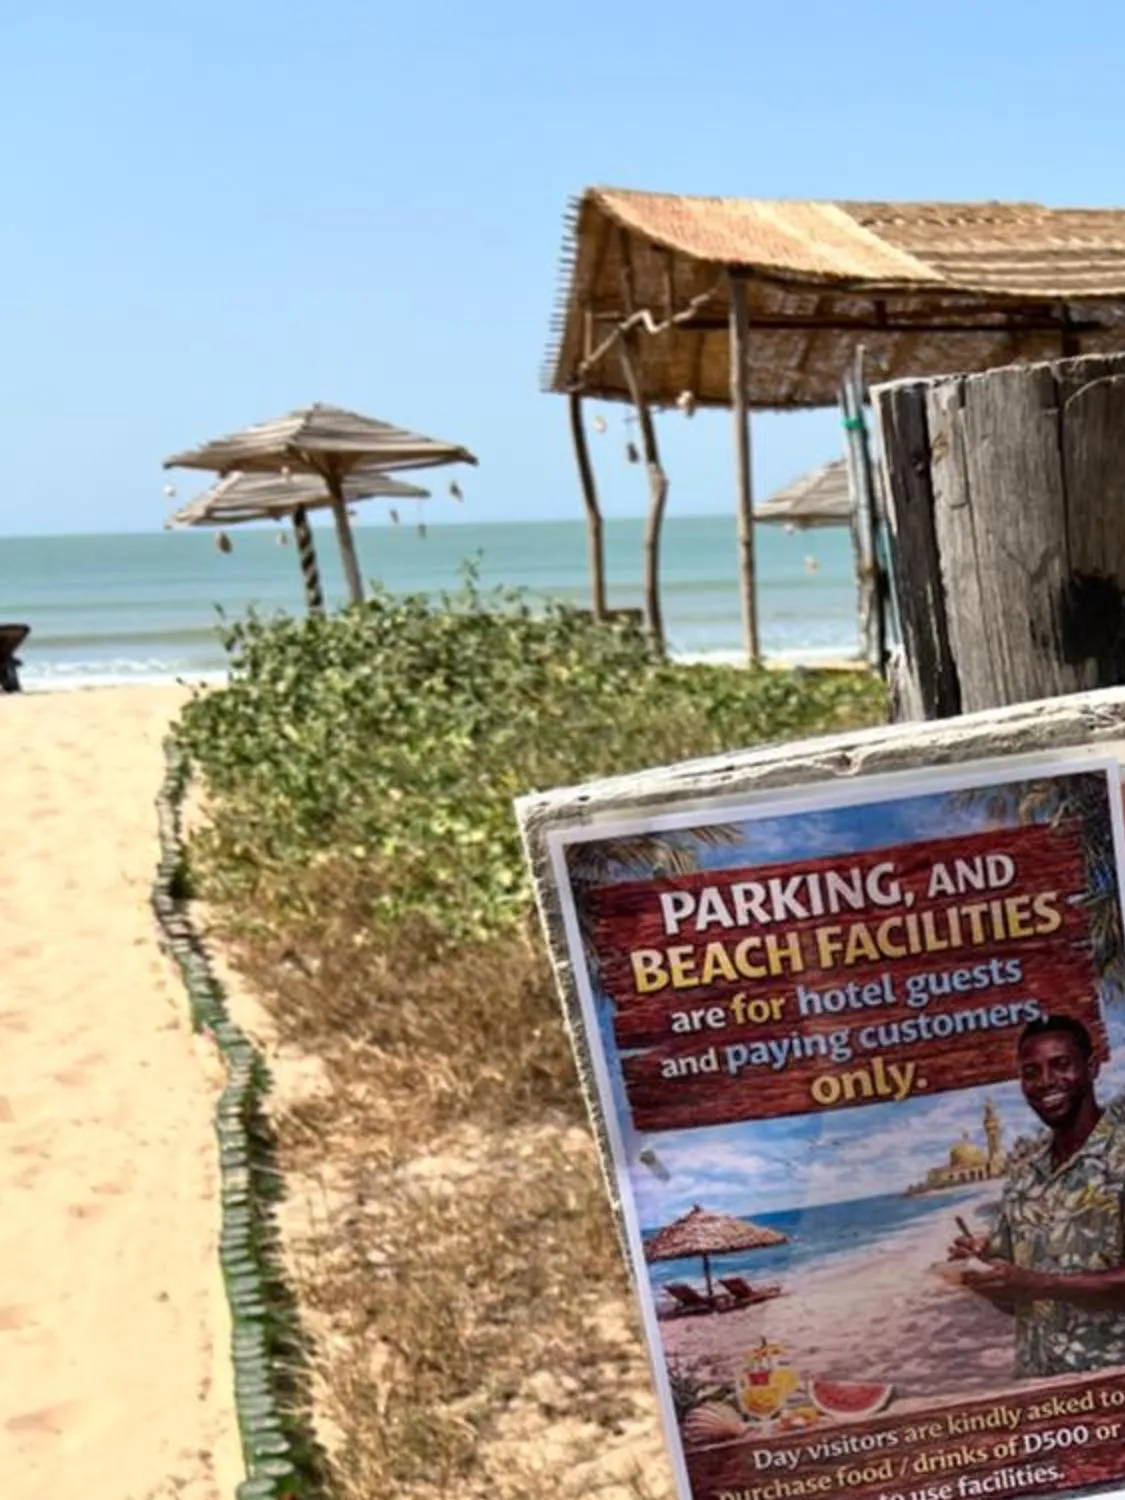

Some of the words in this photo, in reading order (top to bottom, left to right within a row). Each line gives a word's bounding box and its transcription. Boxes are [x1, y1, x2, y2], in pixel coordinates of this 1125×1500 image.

[660, 862, 916, 935] PARKING,
[928, 855, 1015, 898] AND
[631, 931, 804, 993] BEACH
[815, 892, 1062, 969] FACILITIES
[671, 1005, 726, 1033] are
[731, 992, 785, 1025] for
[797, 971, 896, 1017] hotel
[905, 958, 1022, 1007] guests
[660, 1046, 720, 1079] and
[726, 1026, 852, 1076] paying
[858, 999, 1049, 1051] customers,
[811, 1058, 927, 1107] only.
[752, 1447, 802, 1473] Day
[807, 1430, 900, 1459] visitors
[904, 1421, 944, 1444] are
[947, 1405, 1022, 1437] kindly
[1026, 1390, 1096, 1421] asked
[1100, 1387, 1125, 1408] to
[836, 1459, 894, 1489] food
[913, 1444, 990, 1475] drinks
[993, 1435, 1022, 1459] of
[1024, 1424, 1090, 1456] D500
[1095, 1422, 1122, 1441] or
[958, 1463, 1066, 1498] facilities.
